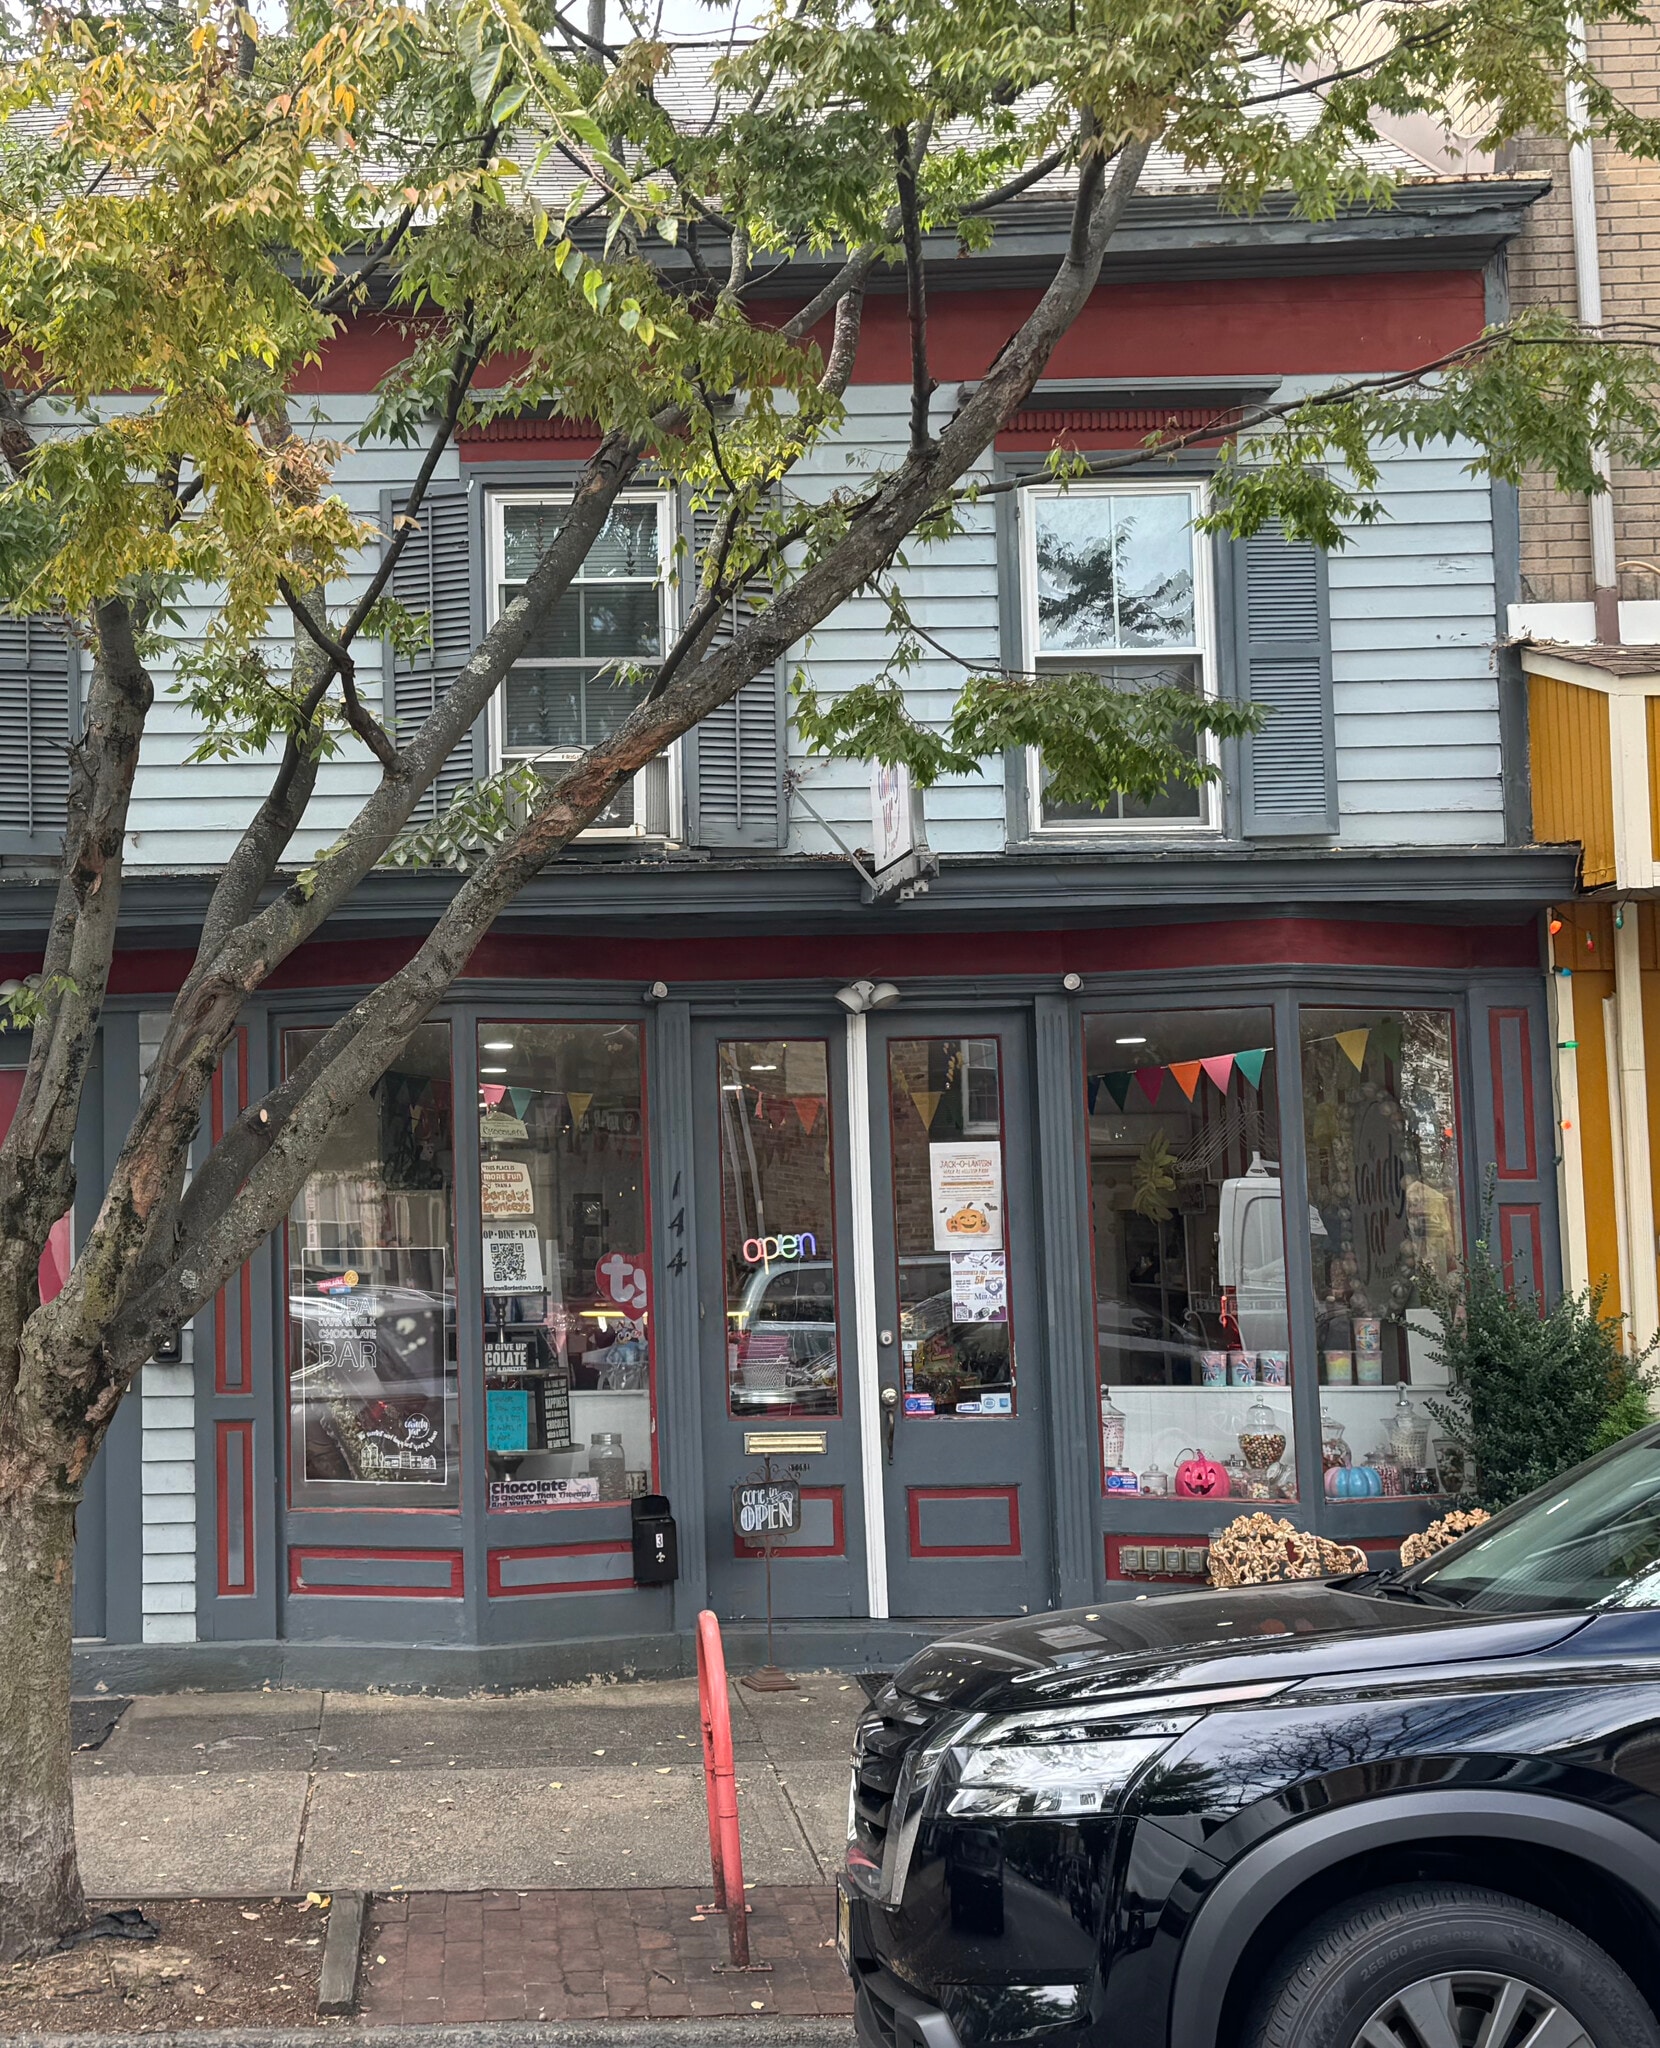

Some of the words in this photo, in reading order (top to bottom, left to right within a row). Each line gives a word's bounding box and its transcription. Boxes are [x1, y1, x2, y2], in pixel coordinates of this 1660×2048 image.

[482, 1187, 516, 1202] Barrel
[498, 1230, 515, 1239] DINE
[519, 1229, 537, 1239] PLAY
[743, 1232, 816, 1275] open
[600, 1254, 647, 1309] ty
[319, 1297, 377, 1316] DUBAI
[318, 1329, 377, 1340] CHOCOLATE
[318, 1340, 377, 1368] BAR
[495, 1343, 515, 1351] GIVE
[515, 1343, 527, 1351] UP
[484, 1351, 528, 1367] COLATE
[491, 1480, 568, 1495] Chocolate
[500, 1493, 535, 1502] Cheaper
[536, 1492, 557, 1500] Than
[741, 1489, 766, 1506] come
[740, 1498, 793, 1532] OPEN
[1360, 1944, 1409, 1982] 255/60
[1411, 1933, 1441, 1951] R18
